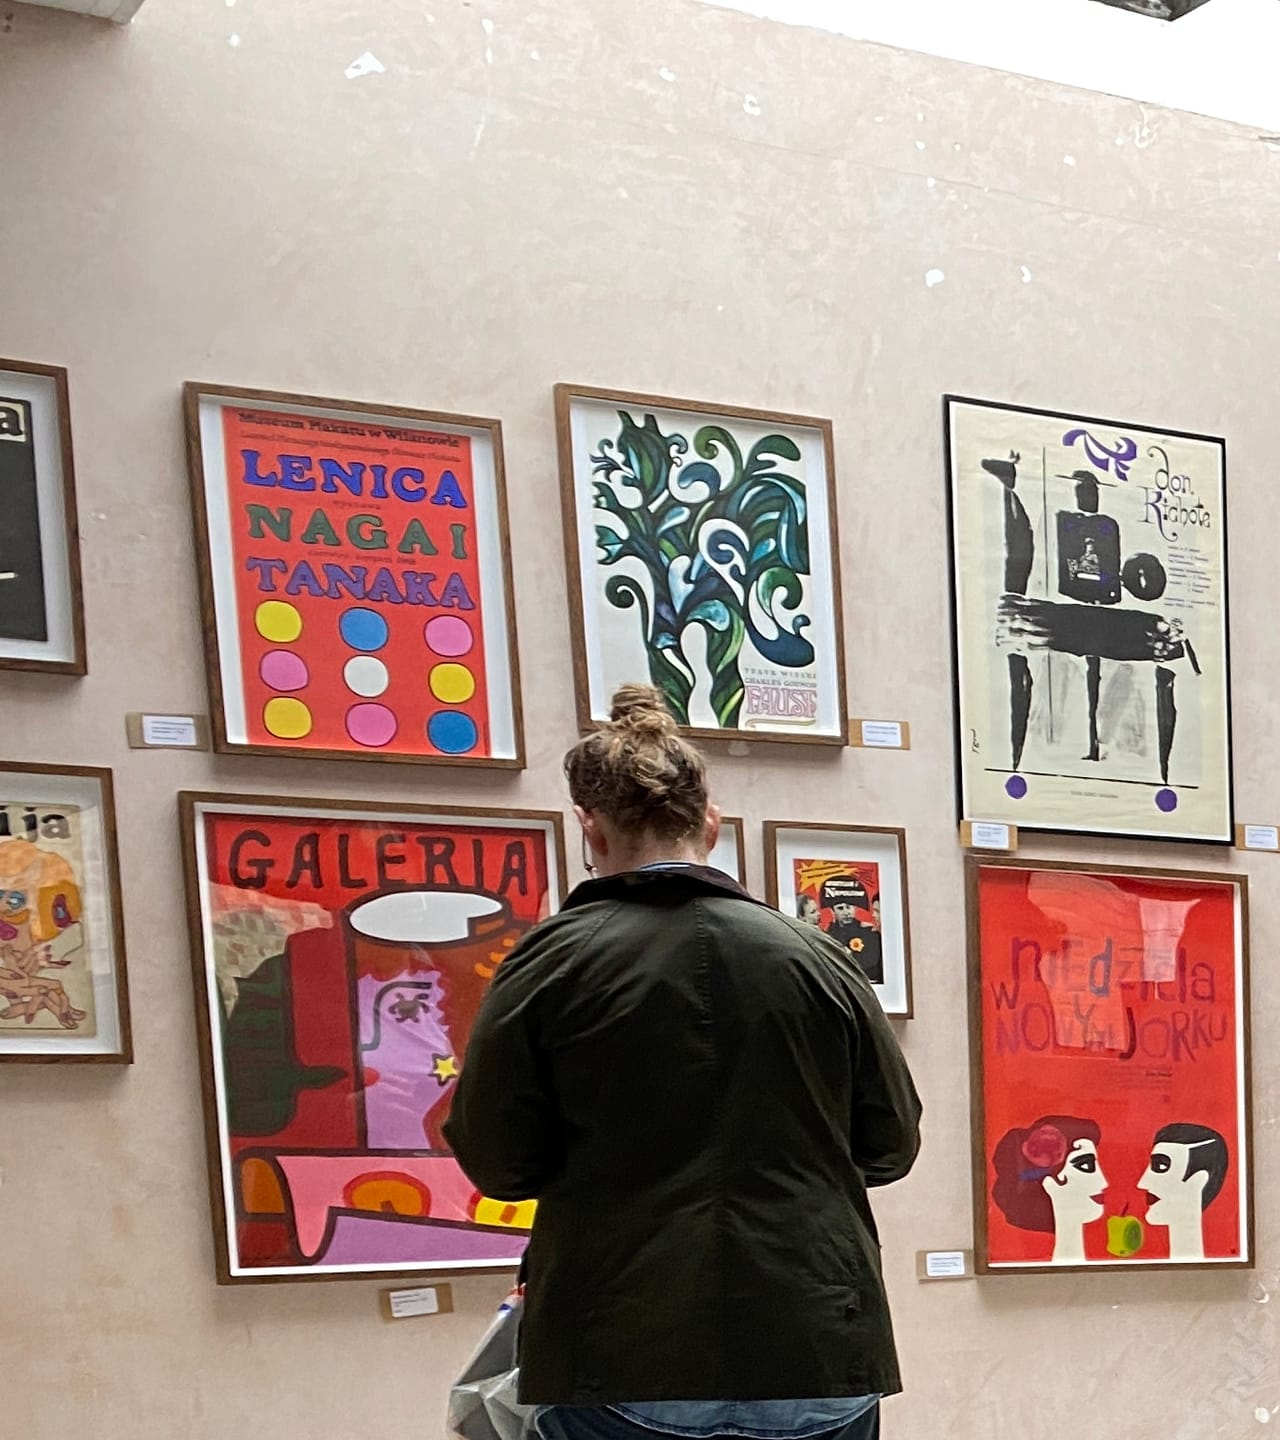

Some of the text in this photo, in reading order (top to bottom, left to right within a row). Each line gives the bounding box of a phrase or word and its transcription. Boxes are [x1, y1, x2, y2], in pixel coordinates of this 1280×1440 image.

[241, 449, 467, 508] LENICA
[245, 556, 476, 610] TANAKA
[228, 829, 528, 896] GALERIA
[1119, 1006, 1228, 1062] JORKU
